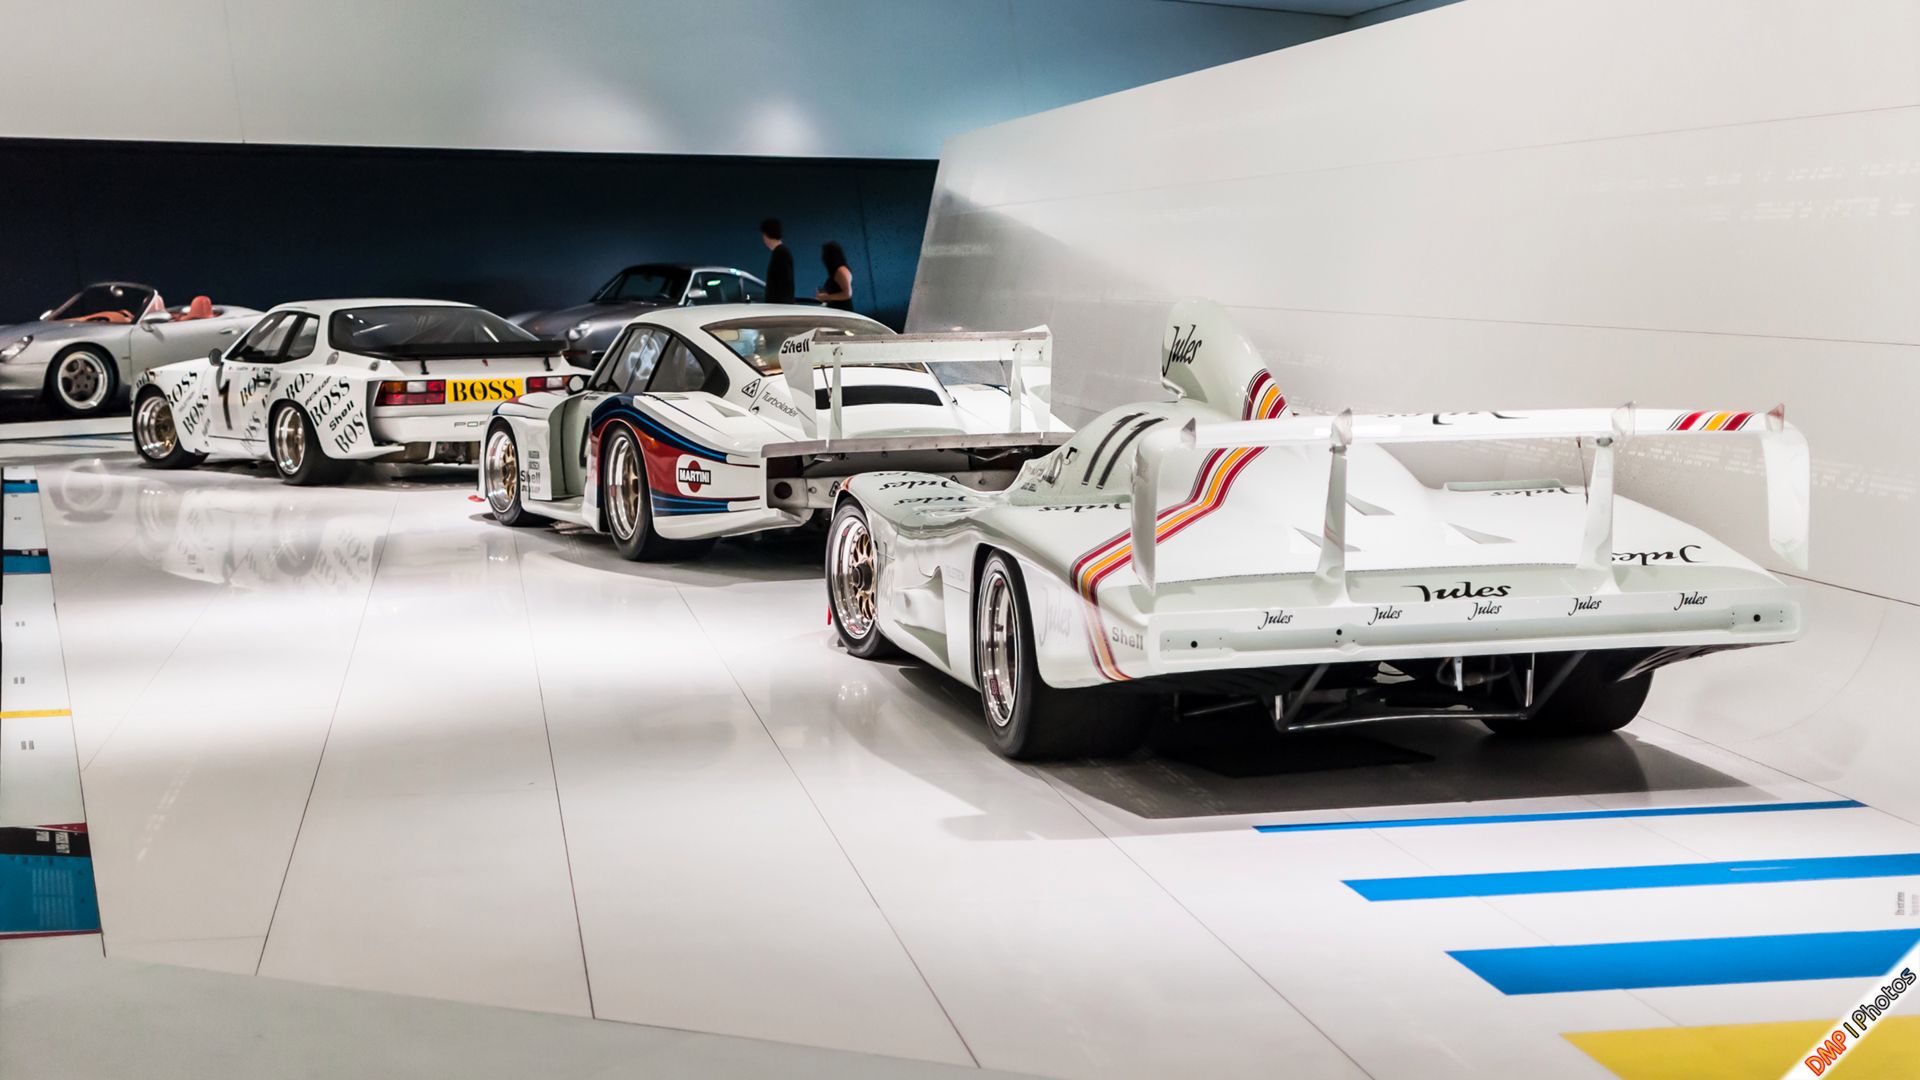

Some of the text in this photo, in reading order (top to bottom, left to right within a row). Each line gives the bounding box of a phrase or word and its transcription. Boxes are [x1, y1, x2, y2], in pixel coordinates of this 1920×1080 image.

[781, 338, 810, 354] Shell
[1161, 323, 1203, 378] Jules
[310, 376, 350, 427] BOSS
[453, 379, 516, 402] BOSS
[183, 394, 208, 436] BOSS
[219, 378, 233, 431] 1
[329, 400, 354, 431] Shell
[762, 391, 798, 417] Turbolader
[1082, 411, 1168, 489] 11
[679, 468, 711, 484] MARTINI
[1400, 581, 1512, 602] Jules
[1673, 591, 1708, 611] Jules
[1367, 605, 1403, 625] Jules
[1467, 601, 1502, 620] Jules
[1567, 596, 1602, 616] Jules
[1257, 609, 1294, 630] Jules
[1112, 626, 1145, 651] Shell
